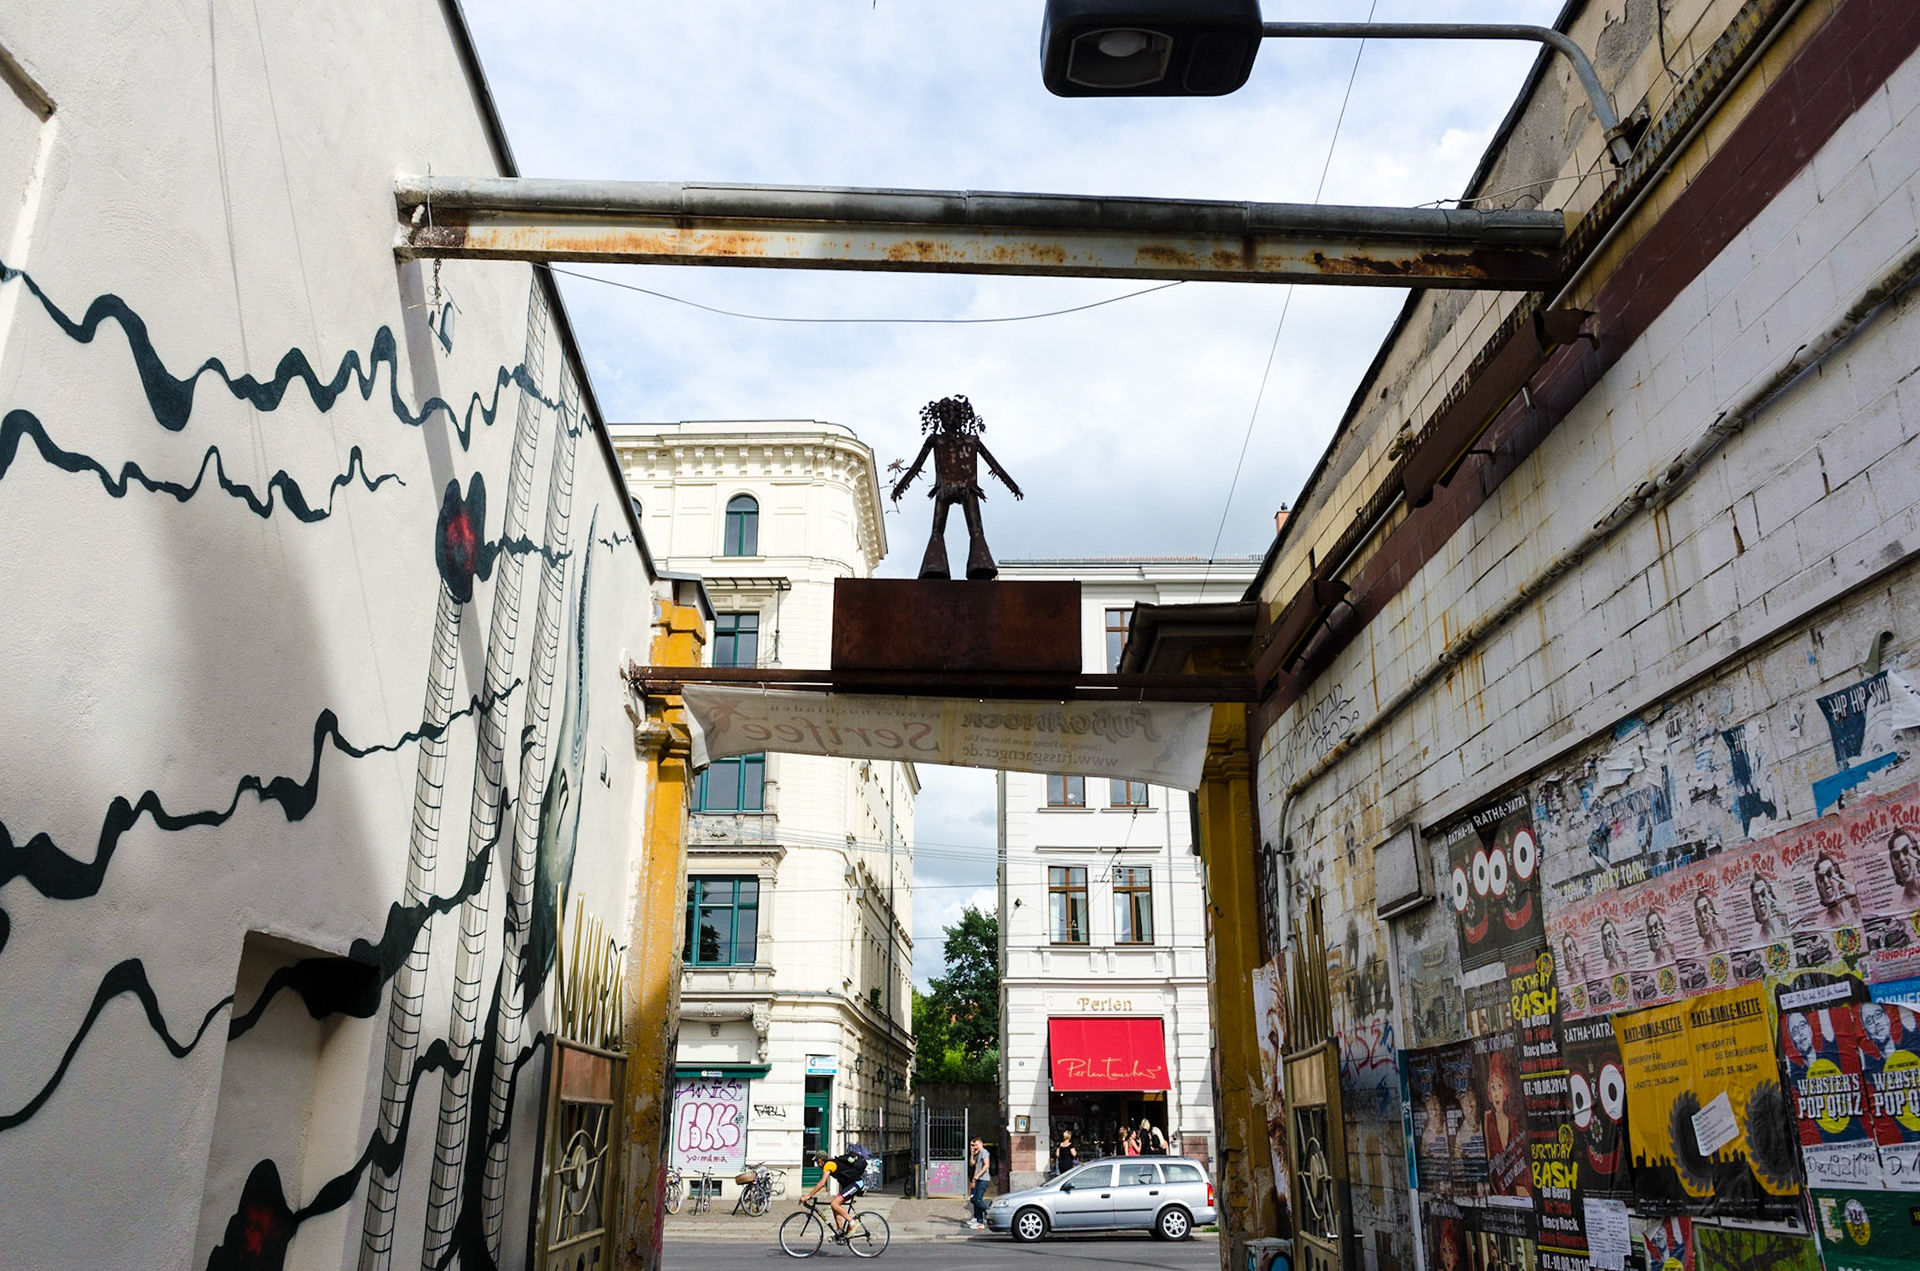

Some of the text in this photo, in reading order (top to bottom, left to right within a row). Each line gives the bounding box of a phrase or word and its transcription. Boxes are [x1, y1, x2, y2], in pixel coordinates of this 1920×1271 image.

[1830, 696, 1848, 720] HIP
[1851, 689, 1866, 713] HIP
[1473, 795, 1528, 826] RATHA-YATRA
[1621, 859, 1647, 886] TONK
[1077, 997, 1132, 1011] Perlen
[1511, 987, 1557, 1020] BASH
[1690, 998, 1762, 1026] ANTI-KOHLE-KETTE
[1521, 1016, 1531, 1028] Bo
[1532, 1014, 1550, 1026] Berry
[1523, 1041, 1557, 1057] Racy Rock
[1726, 1037, 1737, 1047] FÜR
[1715, 1052, 1724, 1061] DIE
[1797, 1072, 1861, 1097] WEBSTER'S
[1798, 1091, 1864, 1121] POP QUIZ
[1873, 1090, 1906, 1117] POP
[1531, 1161, 1578, 1190] BASH
[1541, 1186, 1571, 1200] Bo Berry
[1542, 1215, 1559, 1231] Racy
[1560, 1216, 1580, 1231] Rock
